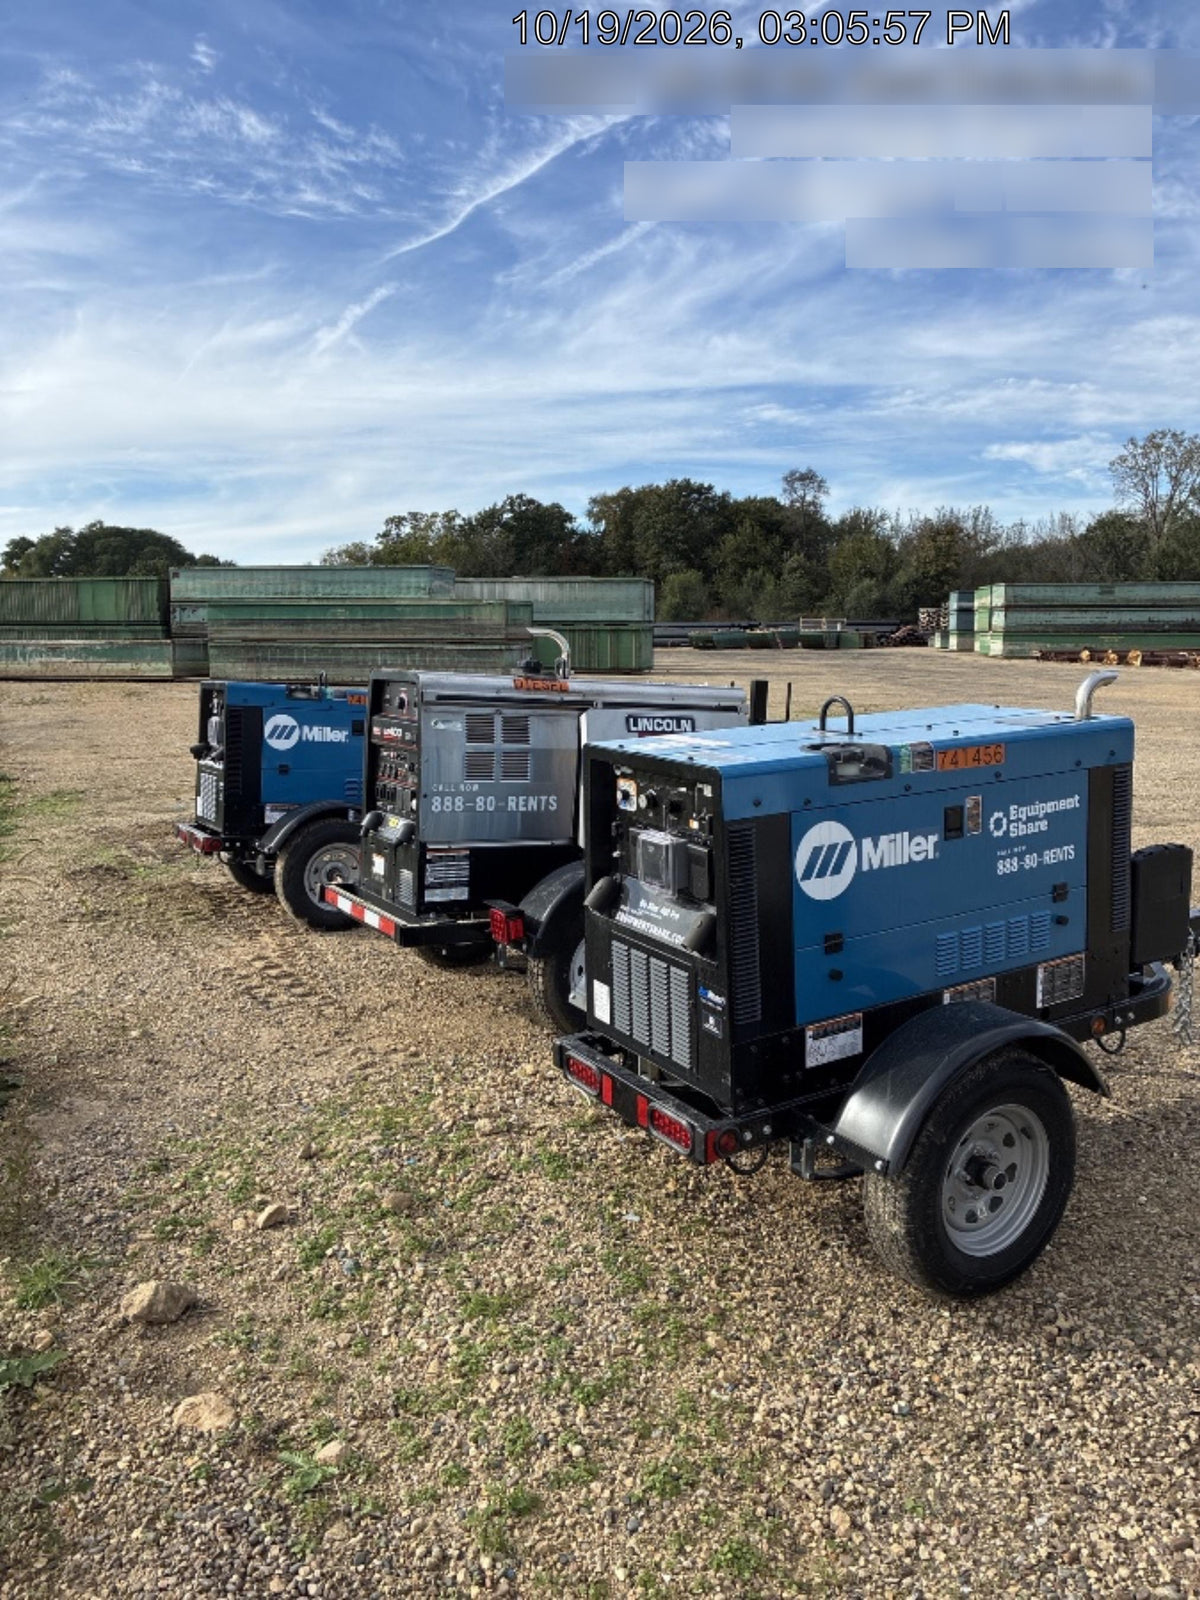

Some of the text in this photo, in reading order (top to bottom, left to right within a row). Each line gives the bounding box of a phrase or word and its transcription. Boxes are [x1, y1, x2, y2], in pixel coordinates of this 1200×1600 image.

[302, 725, 349, 742] Miller
[629, 717, 692, 732] LINCOLN
[938, 744, 1003, 767] 741456
[1009, 794, 1080, 821] Equipment
[1009, 819, 1048, 837] Share
[862, 831, 939, 871] Miller
[996, 844, 1075, 875] 888-80-RENTS
